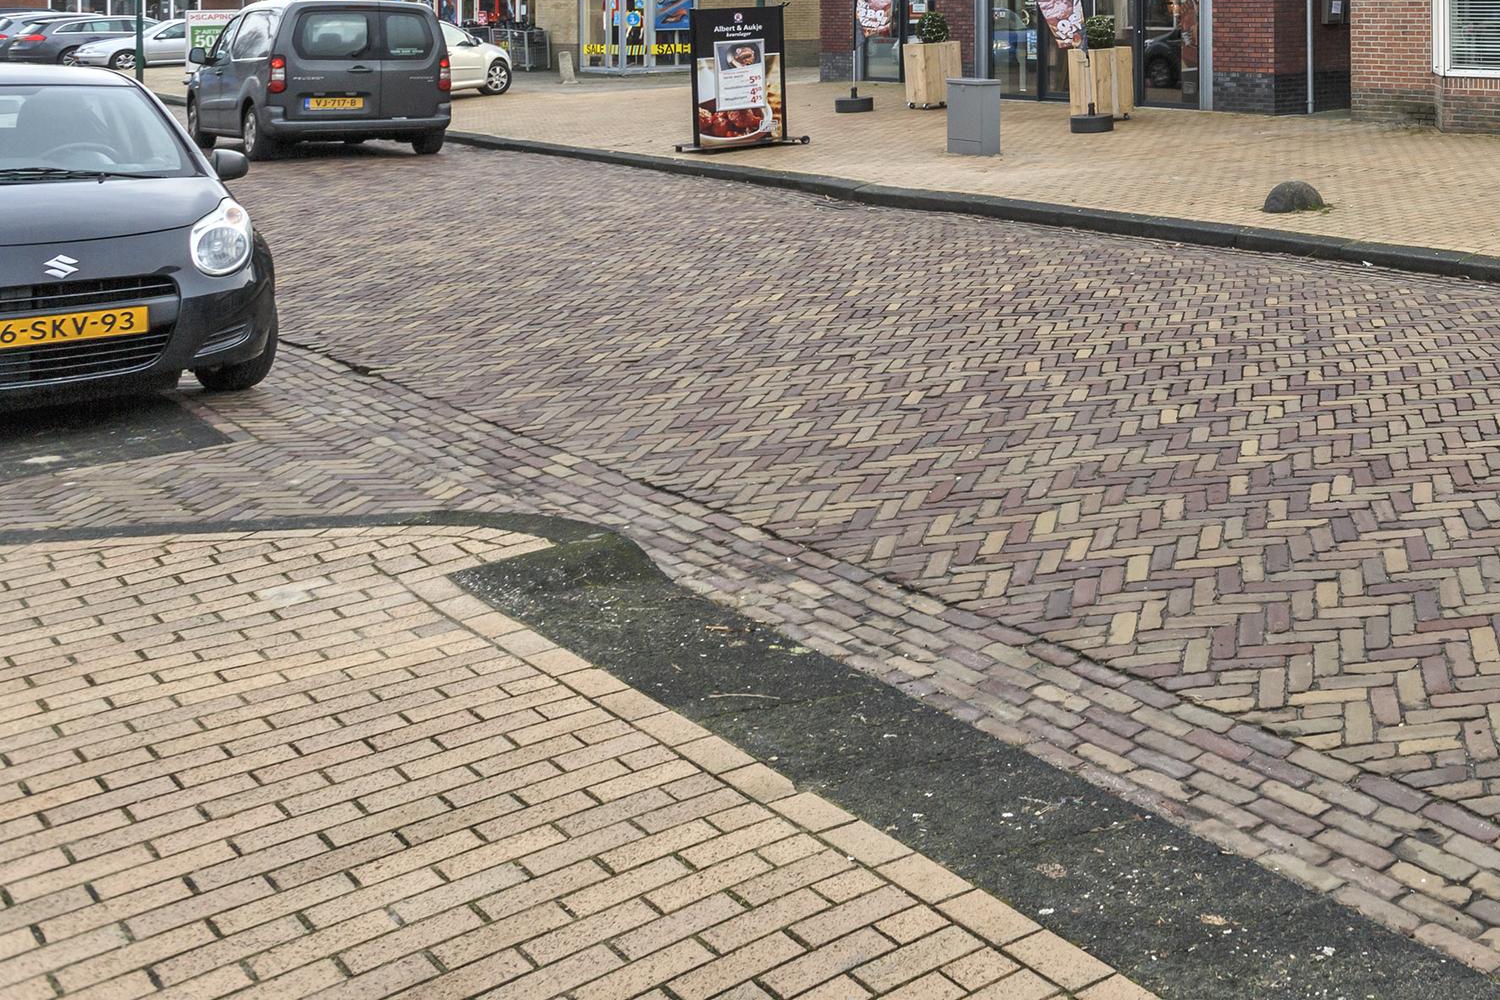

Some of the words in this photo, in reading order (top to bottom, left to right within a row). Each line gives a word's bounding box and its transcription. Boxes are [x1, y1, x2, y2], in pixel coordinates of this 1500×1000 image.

[714, 25, 736, 33] Albert
[743, 23, 763, 31] Aukje
[586, 44, 604, 55] SALE
[315, 98, 357, 108] VJ-717-B
[0, 311, 135, 344] 6-SKV-93
